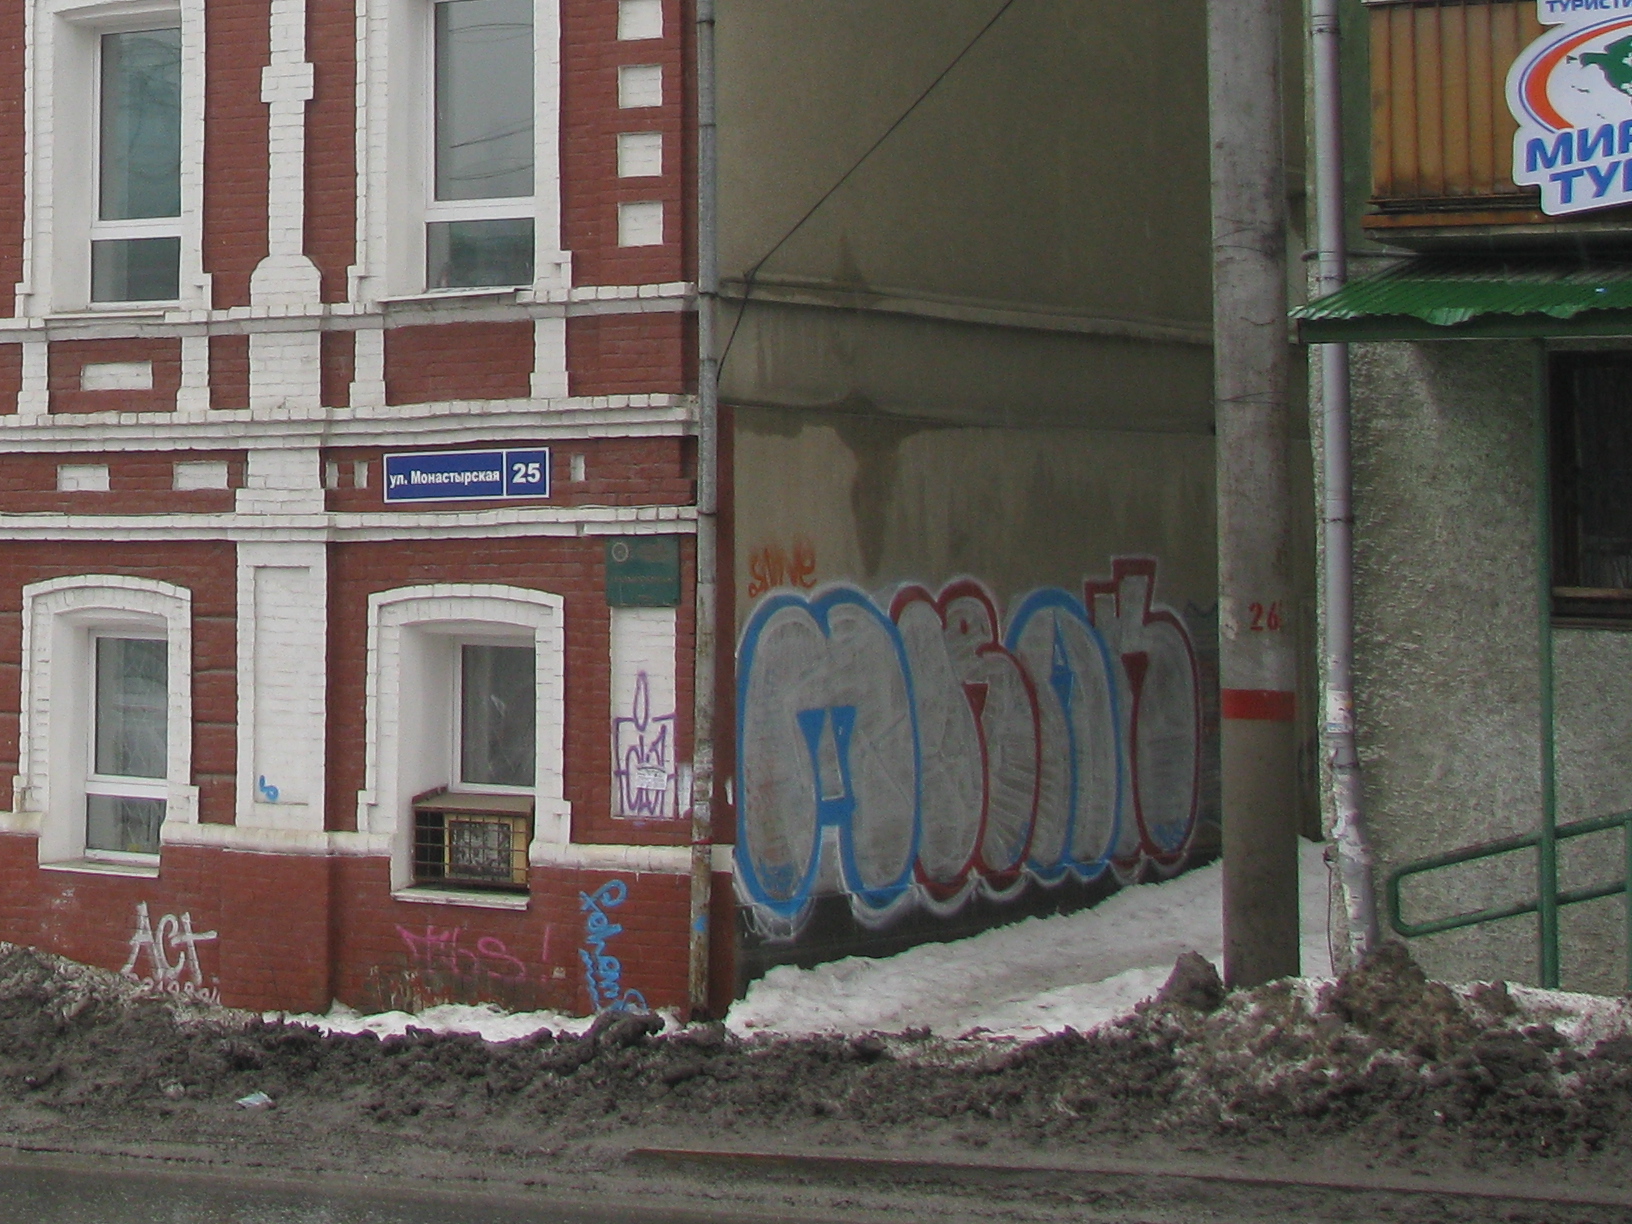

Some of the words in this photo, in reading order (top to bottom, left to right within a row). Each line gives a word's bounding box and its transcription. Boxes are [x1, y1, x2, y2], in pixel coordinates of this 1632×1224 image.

[389, 474, 408, 488] ул.
[410, 470, 500, 485] Монастырская
[512, 463, 541, 484] 25
